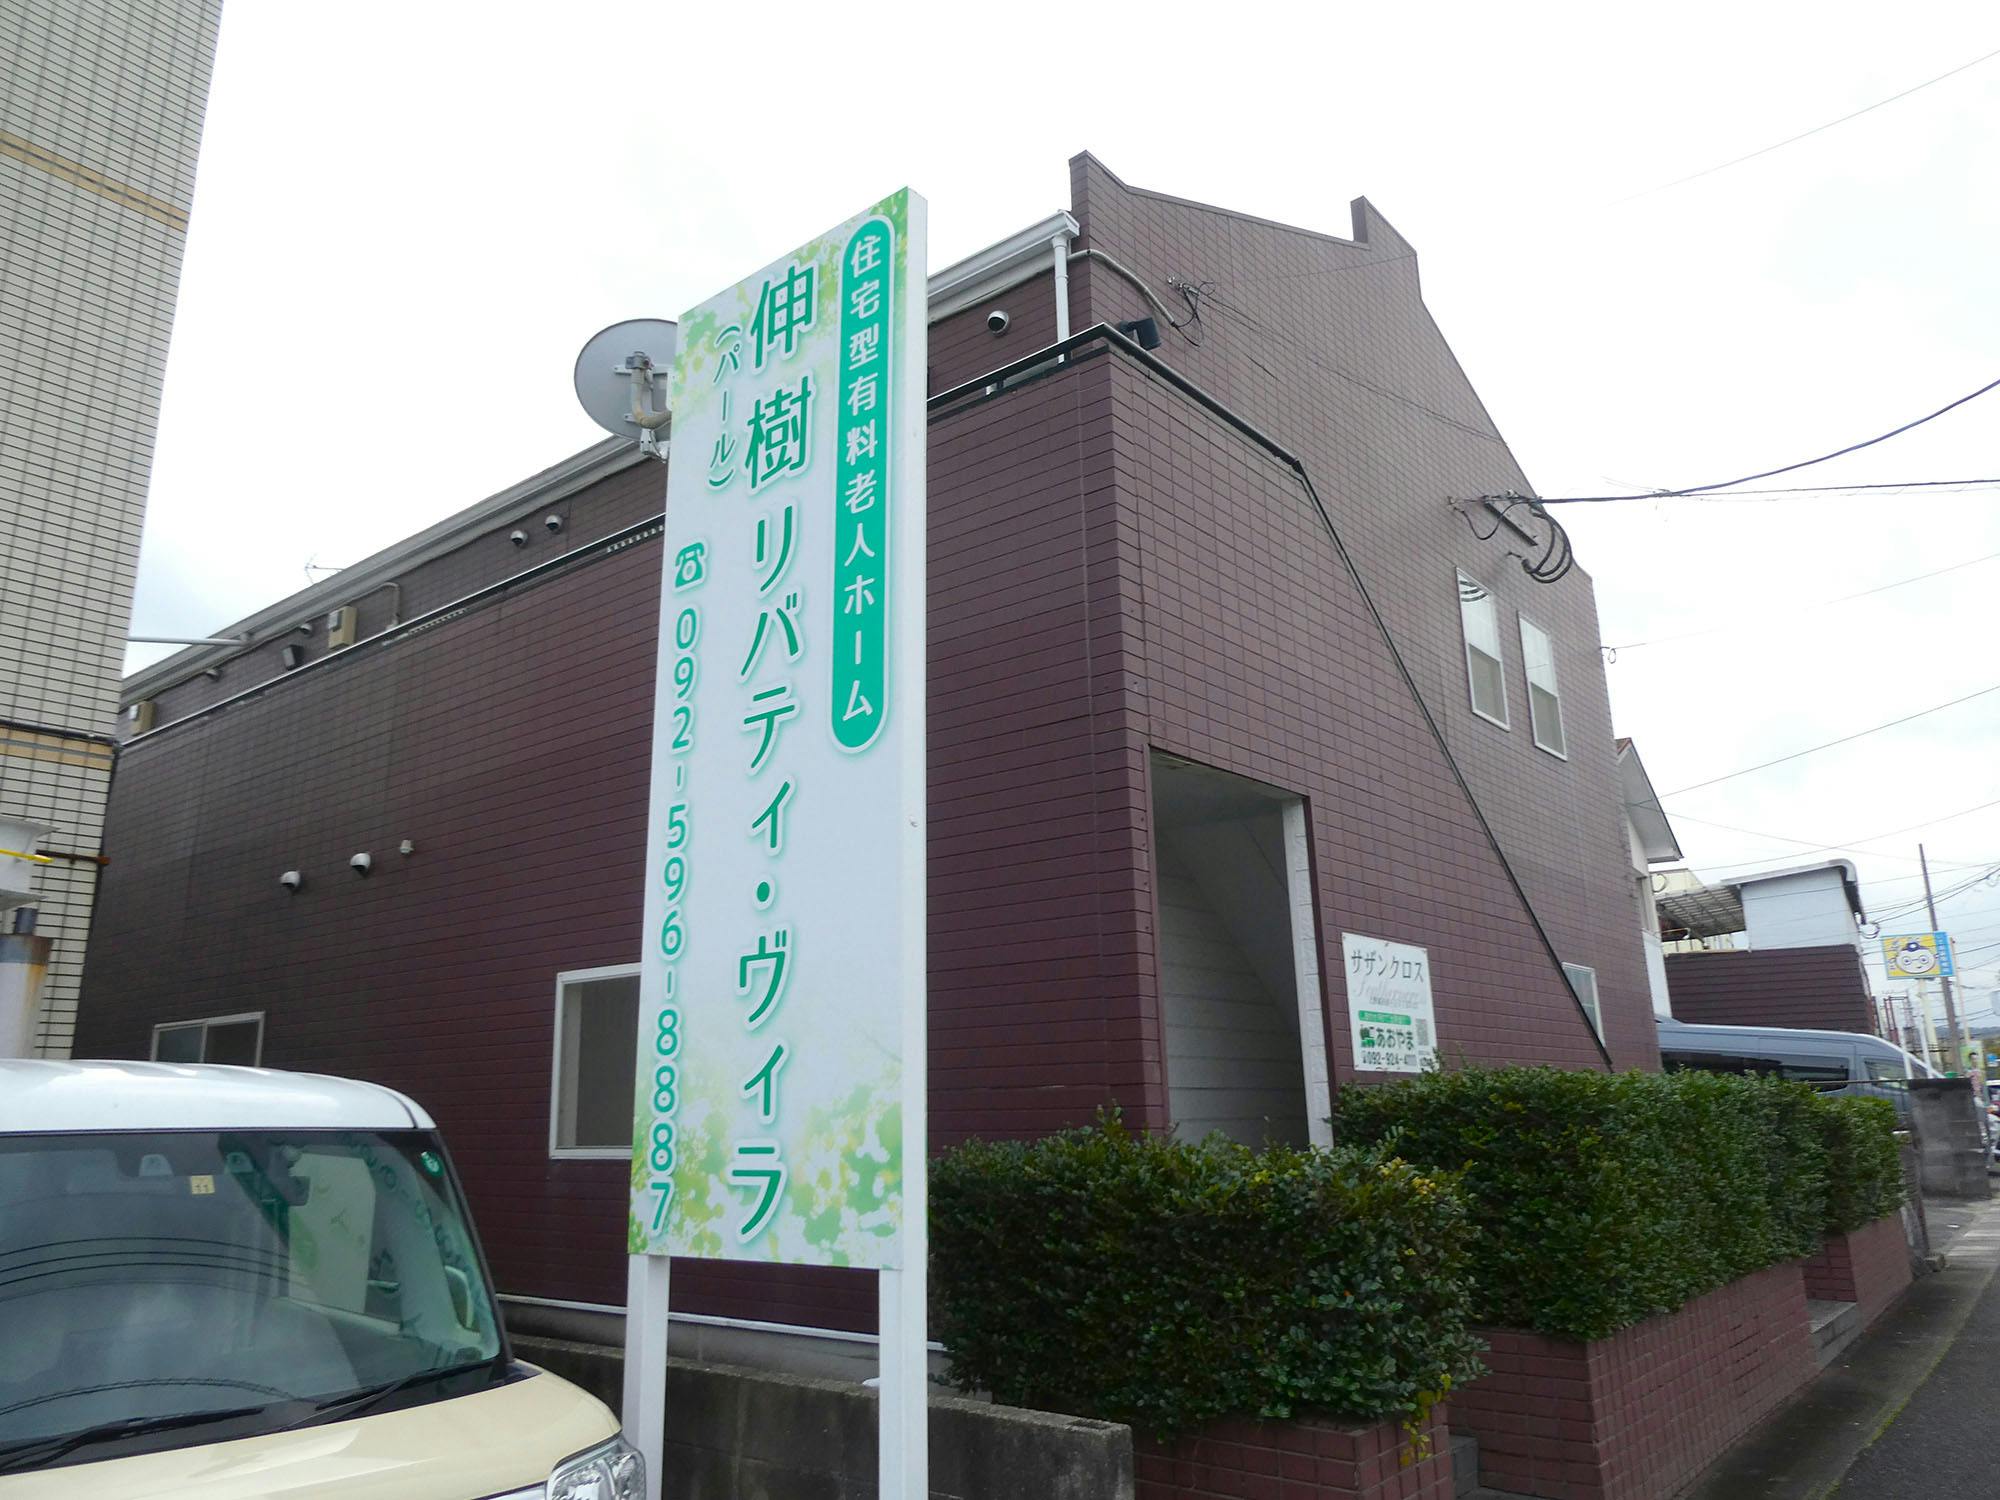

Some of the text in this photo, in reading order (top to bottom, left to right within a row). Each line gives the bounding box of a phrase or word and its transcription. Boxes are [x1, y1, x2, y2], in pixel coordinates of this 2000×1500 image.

[841, 233, 882, 722] 住宅型有料老人ホーム
[652, 608, 697, 1230] 092-596-8887
[1351, 950, 1424, 983] サザンクロス
